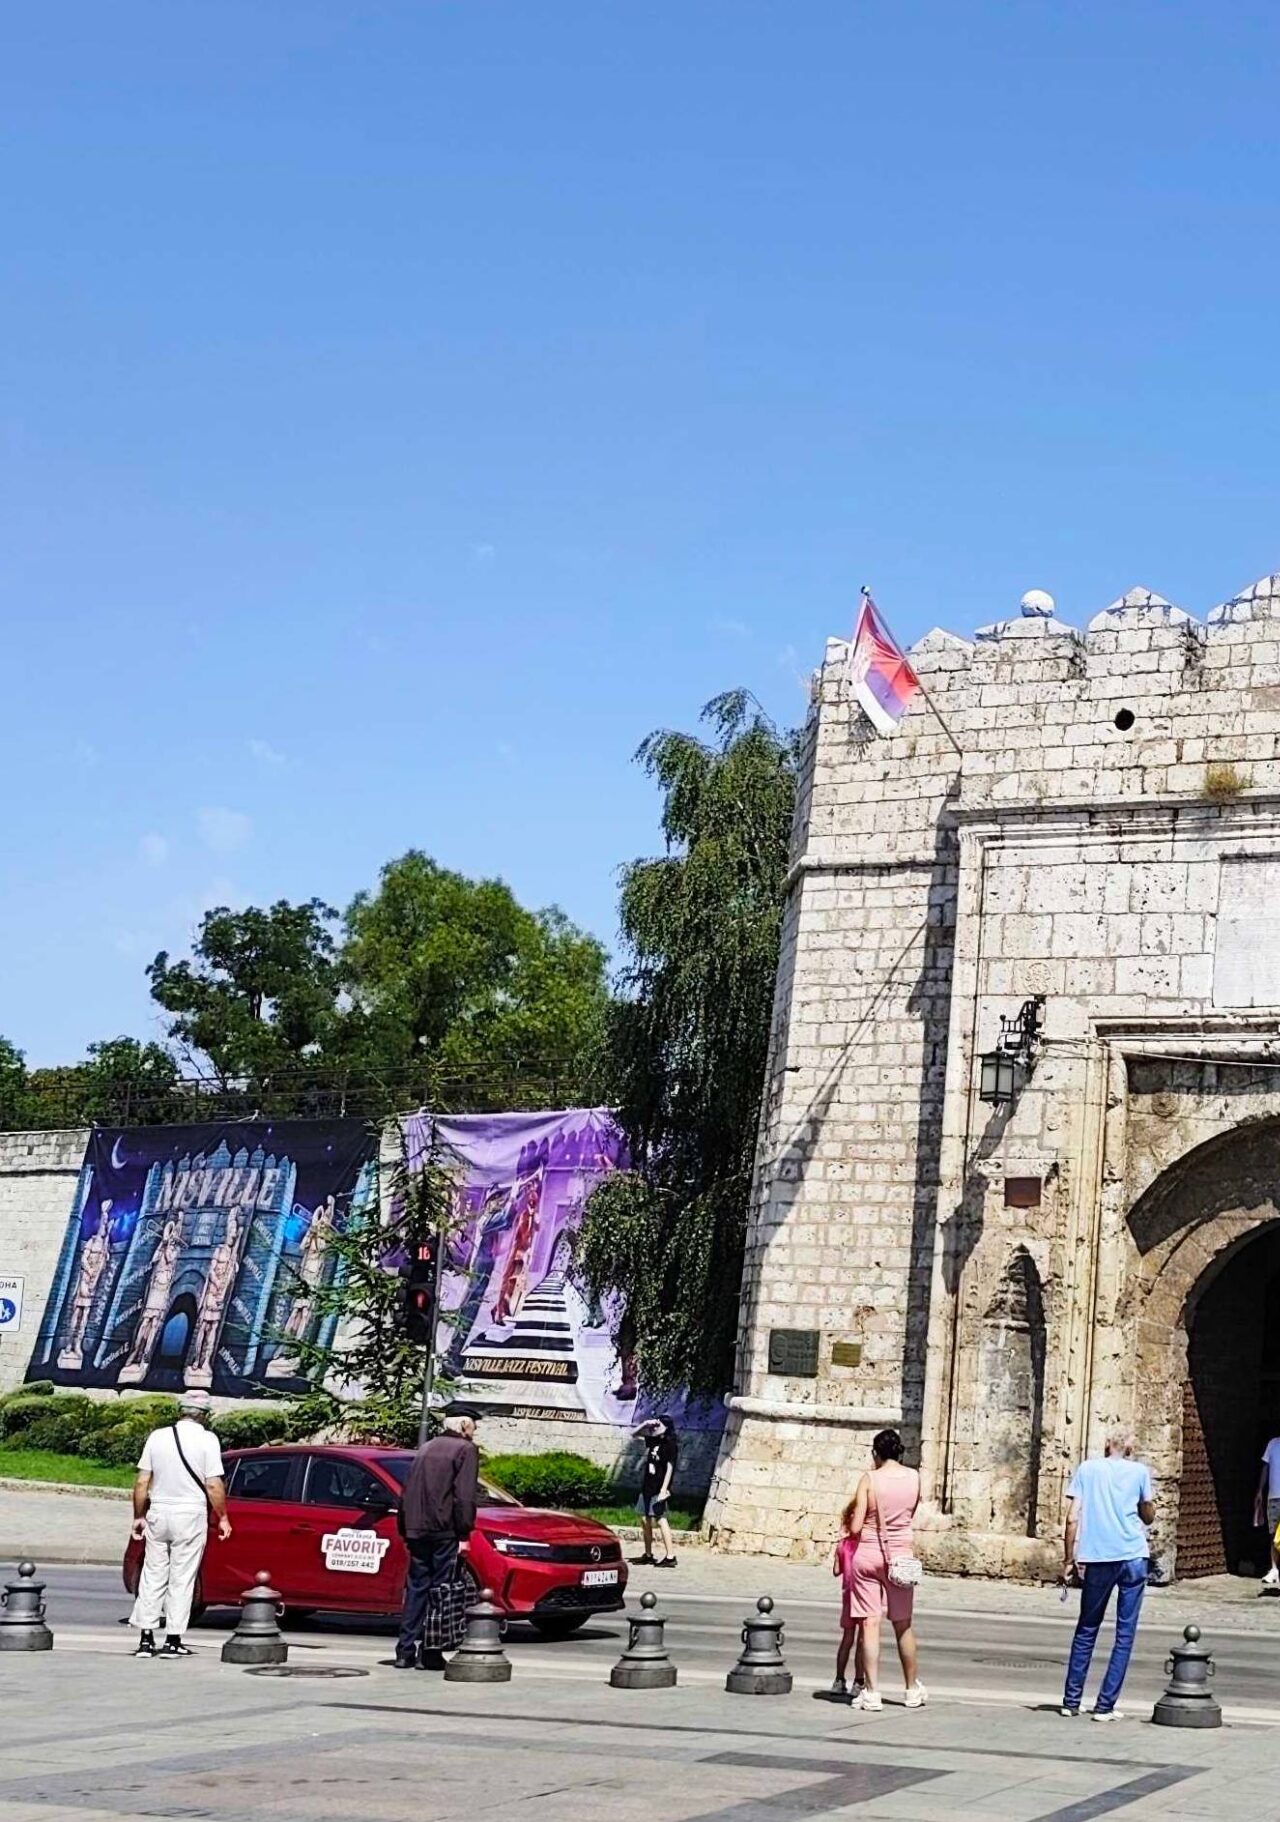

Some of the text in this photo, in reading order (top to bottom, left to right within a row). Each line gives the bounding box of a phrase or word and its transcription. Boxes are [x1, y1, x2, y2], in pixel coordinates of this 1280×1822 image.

[463, 1358, 568, 1376] NISVILLE JAZZ FESTIVAL
[325, 1538, 385, 1554] FAVORIT
